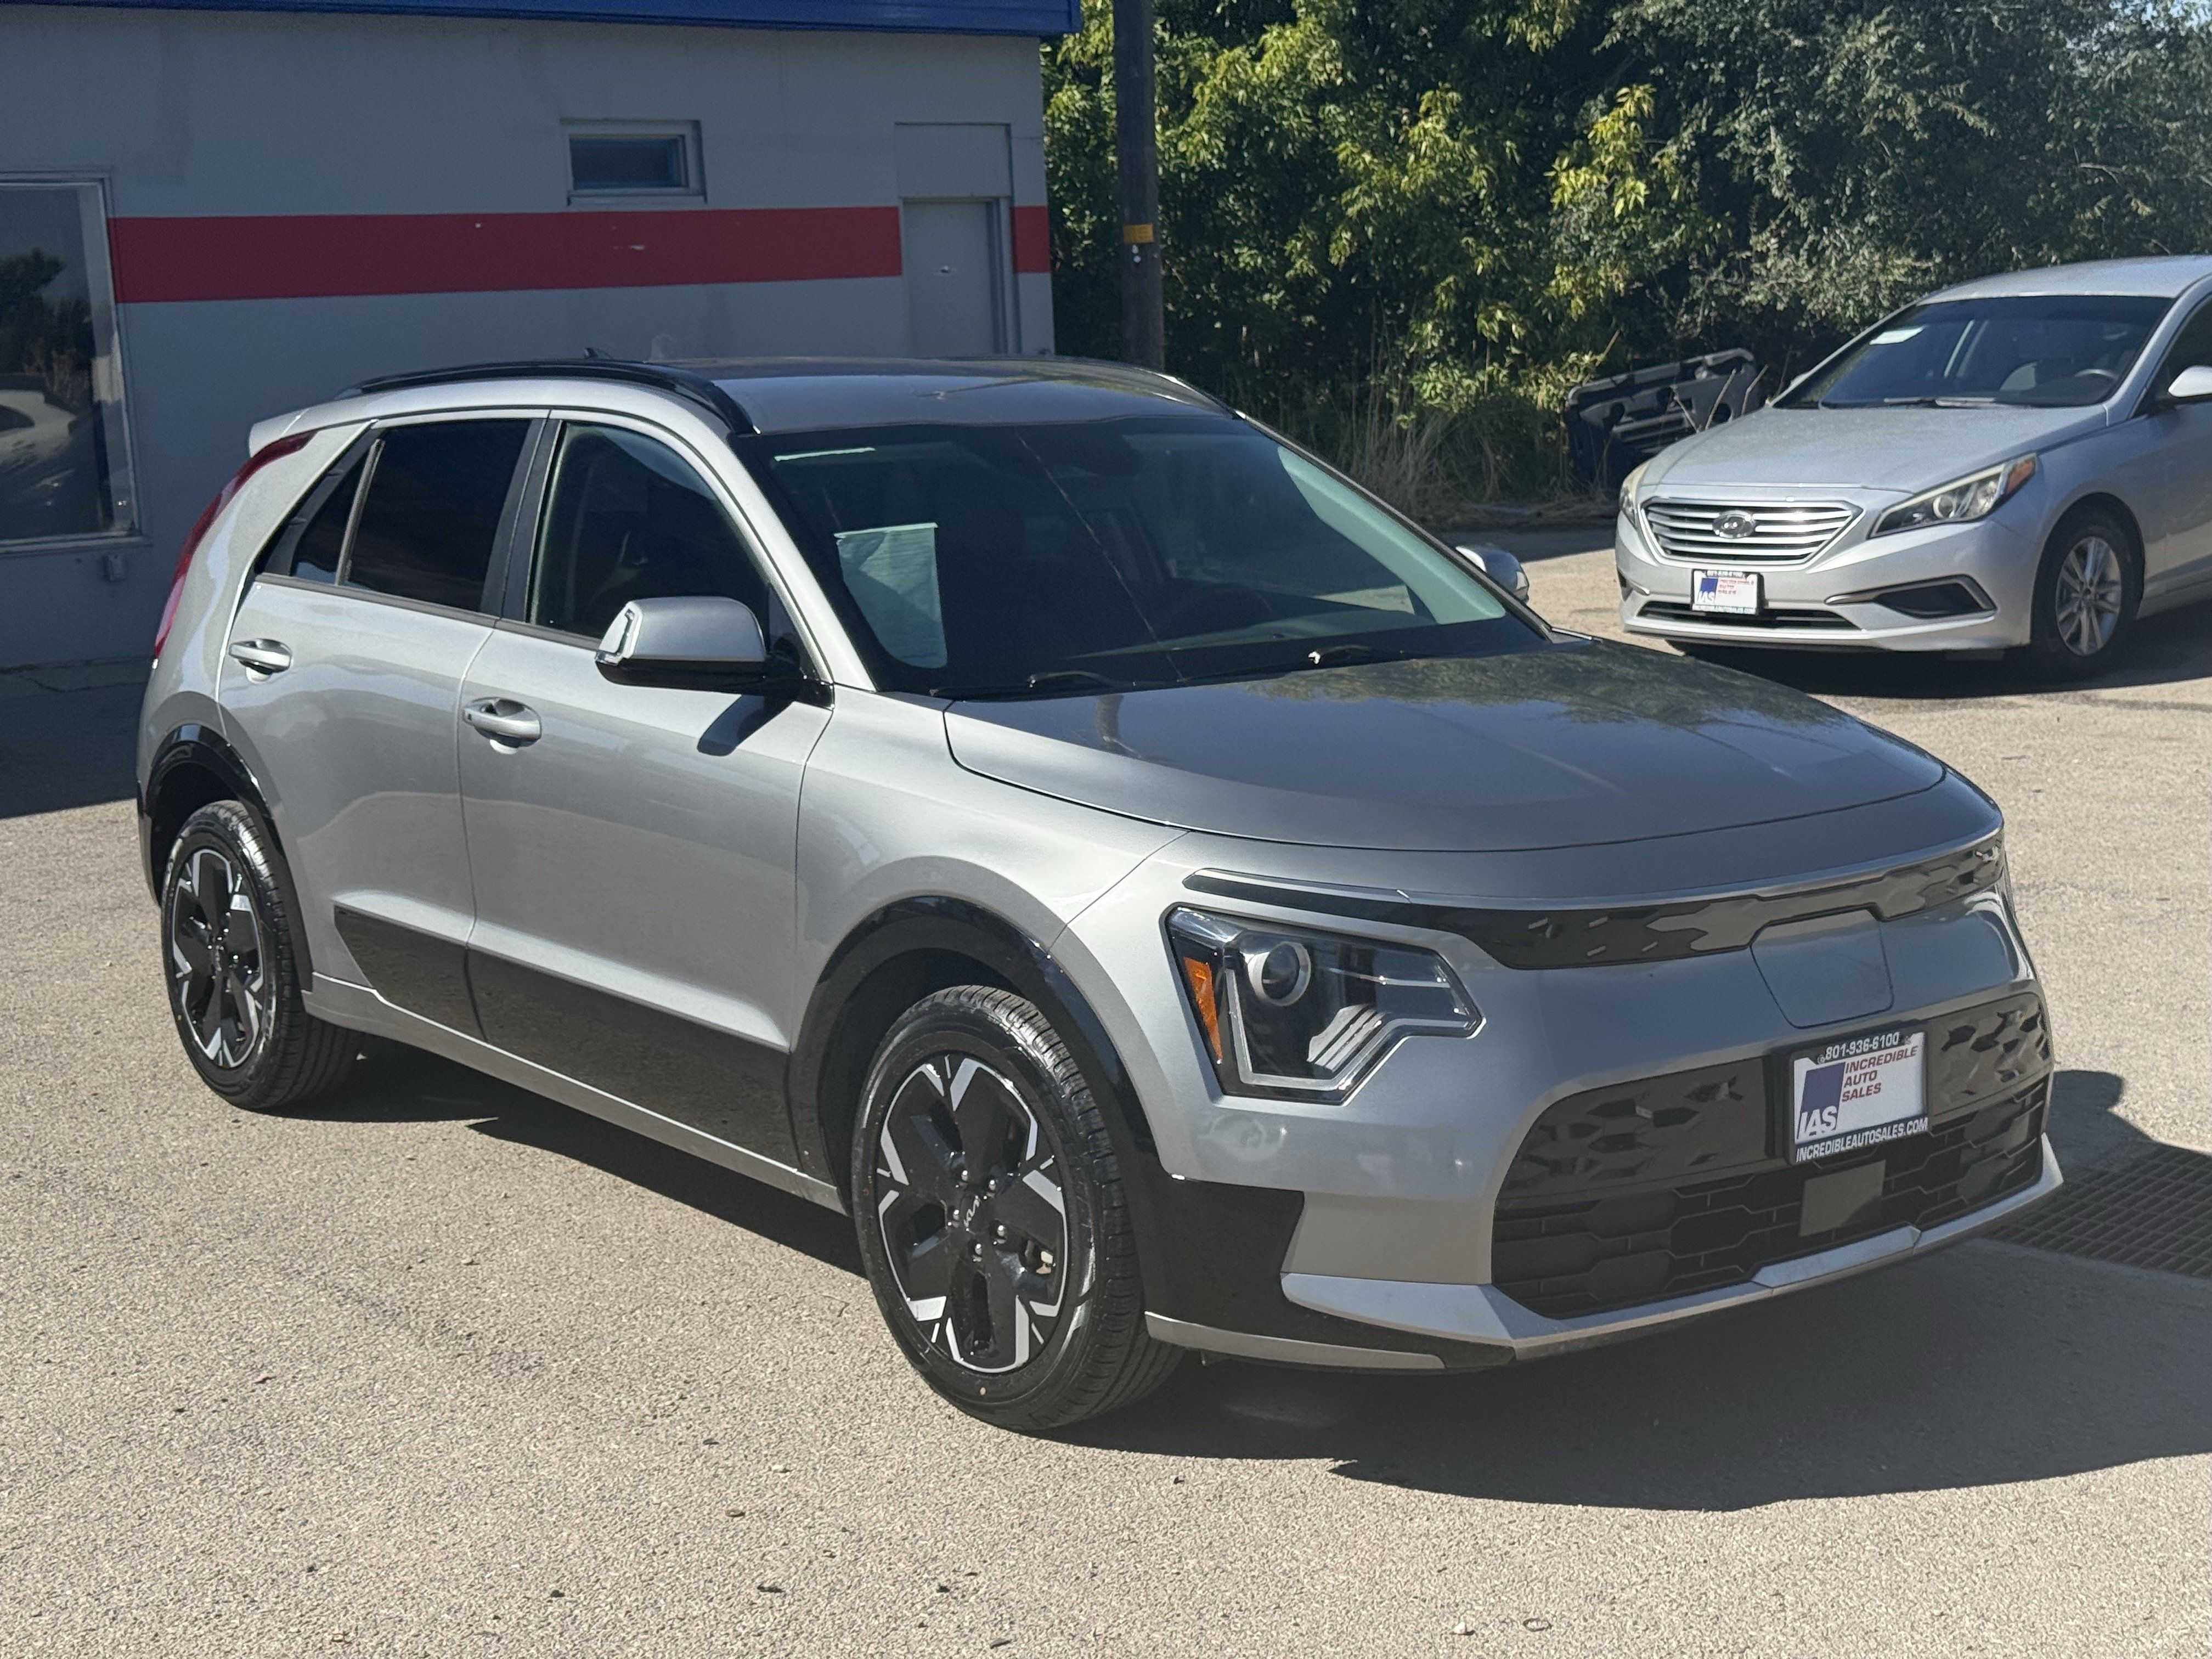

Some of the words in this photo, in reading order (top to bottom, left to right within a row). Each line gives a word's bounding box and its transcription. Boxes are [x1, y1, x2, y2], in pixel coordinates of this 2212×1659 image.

[1825, 1032, 1900, 1060] 801-936-6100
[1845, 1046, 1918, 1074] INCREDIBLE
[1842, 1083, 1882, 1102] SALES
[1843, 1070, 1878, 1088] AUTO
[1797, 1105, 1837, 1139] IAS
[1796, 1117, 1928, 1163] INCREDIBLEAUTOSALES.COM
